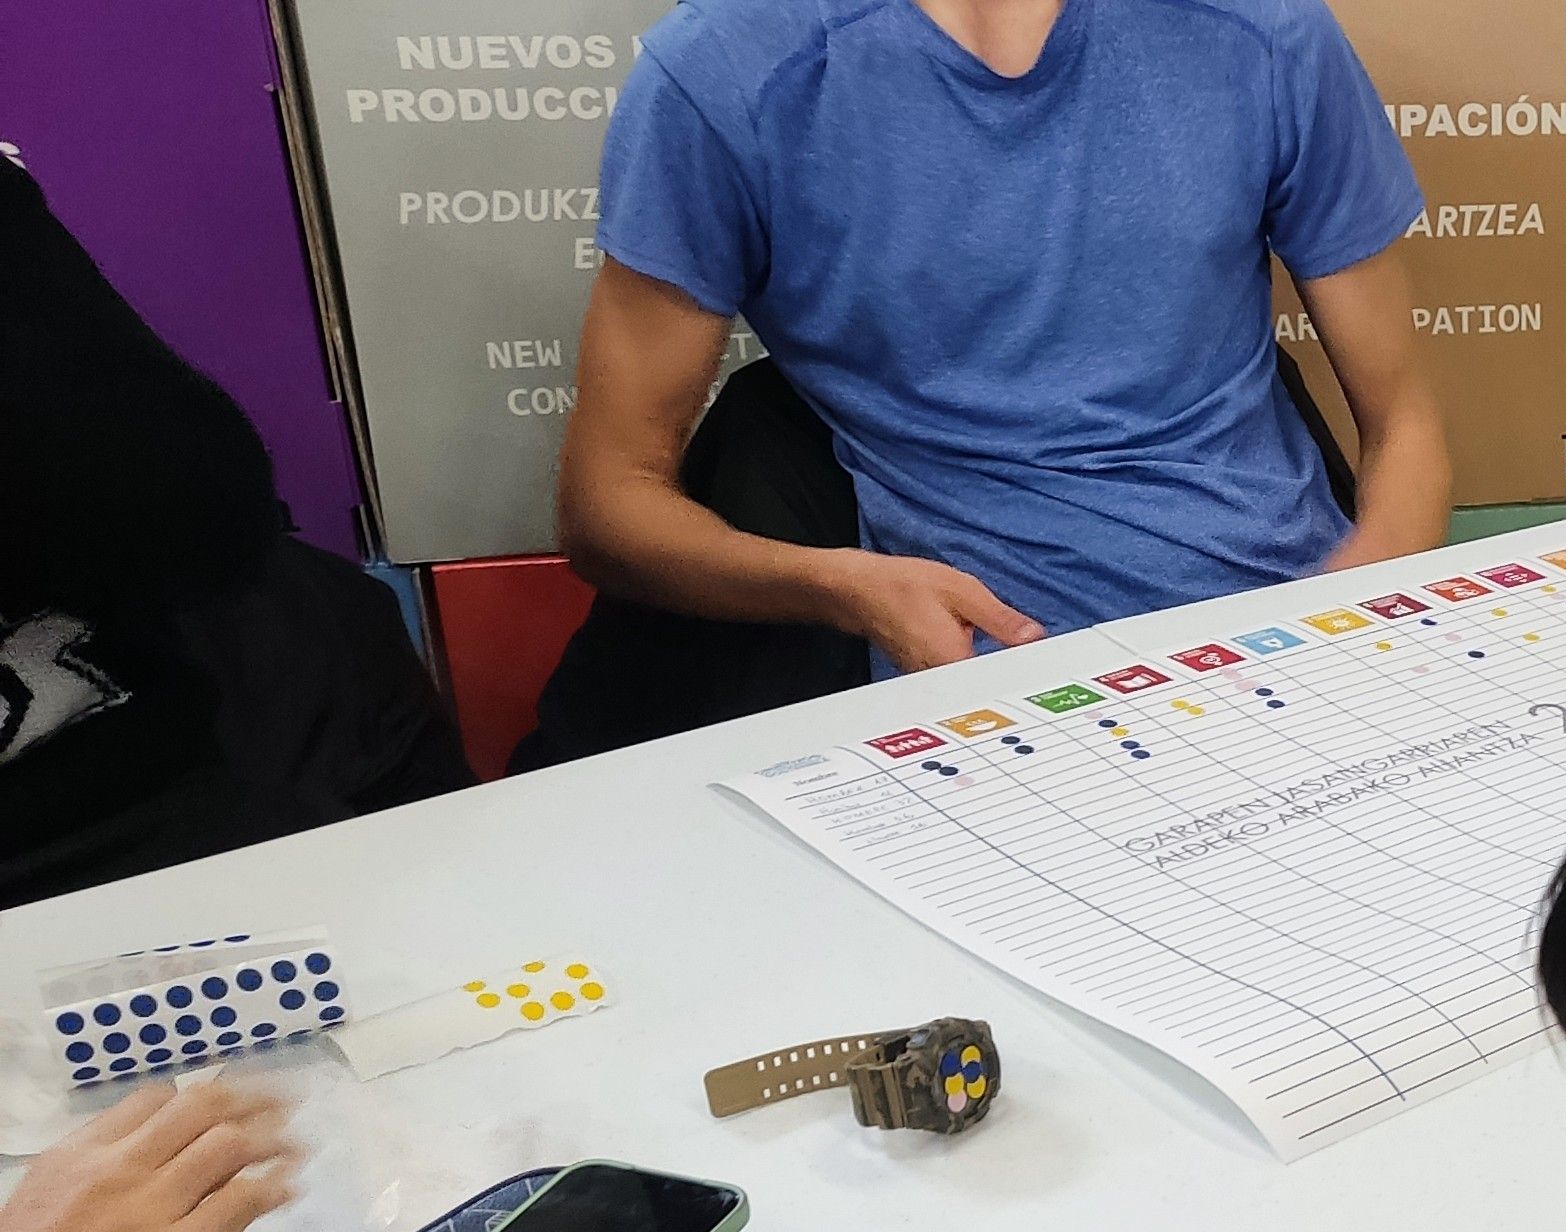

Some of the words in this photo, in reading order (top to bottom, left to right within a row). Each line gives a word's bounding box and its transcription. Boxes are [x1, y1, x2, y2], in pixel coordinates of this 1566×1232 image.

[396, 35, 616, 71] NUEVOS
[347, 86, 616, 123] PRODUCCI
[400, 187, 600, 224] PRODUKZ
[1404, 202, 1545, 239] ARTZEA
[486, 339, 562, 369] NEW
[1125, 797, 1270, 852] GARAPEN
[1273, 719, 1512, 803] JASANGARRIAREN
[1155, 823, 1270, 868] ALDEKO
[1278, 772, 1411, 826] ARABAKO
[1417, 732, 1544, 779] ALIANTZA
